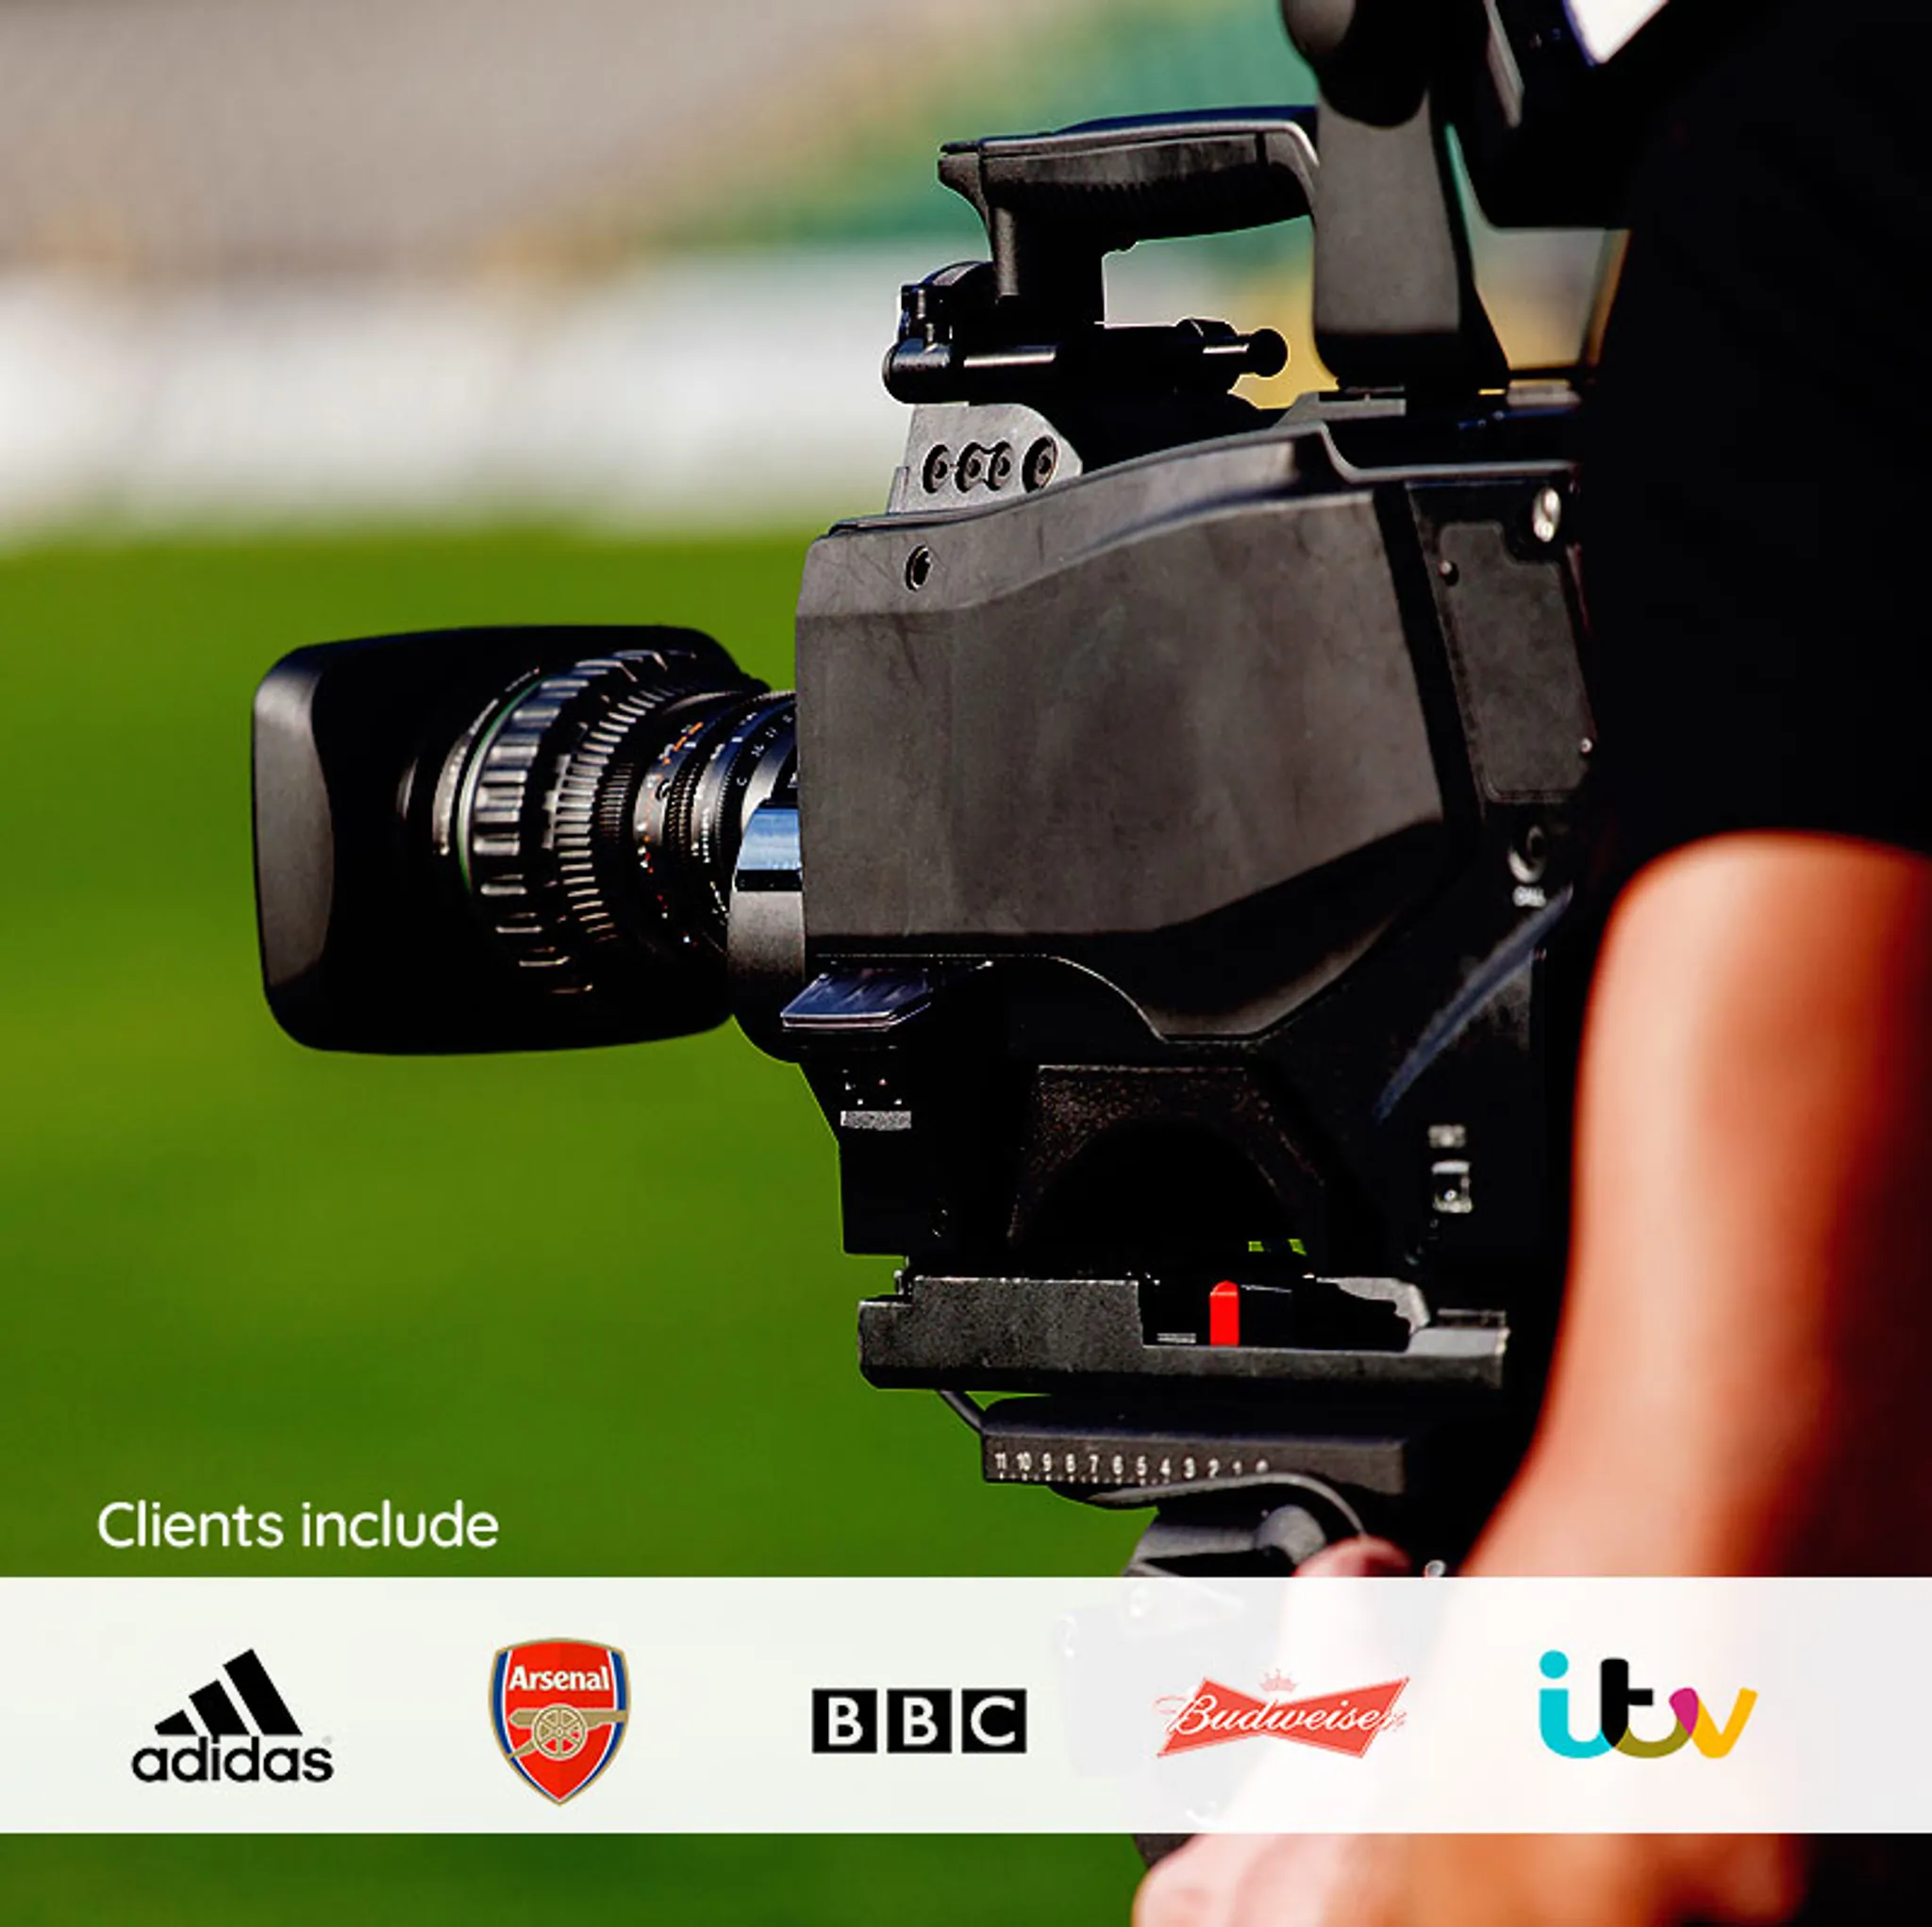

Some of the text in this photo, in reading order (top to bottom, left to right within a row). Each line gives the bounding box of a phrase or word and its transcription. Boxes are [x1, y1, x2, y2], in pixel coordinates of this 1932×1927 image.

[994, 1452, 1008, 1470] 11
[1016, 1452, 1033, 1471] 10
[1042, 1453, 1052, 1472] 9
[1065, 1454, 1075, 1473] 8
[1089, 1454, 1099, 1473] 7
[1112, 1454, 1124, 1475] 6
[1136, 1455, 1147, 1476] 5
[1158, 1457, 1172, 1475] 4
[1183, 1457, 1195, 1478] 3
